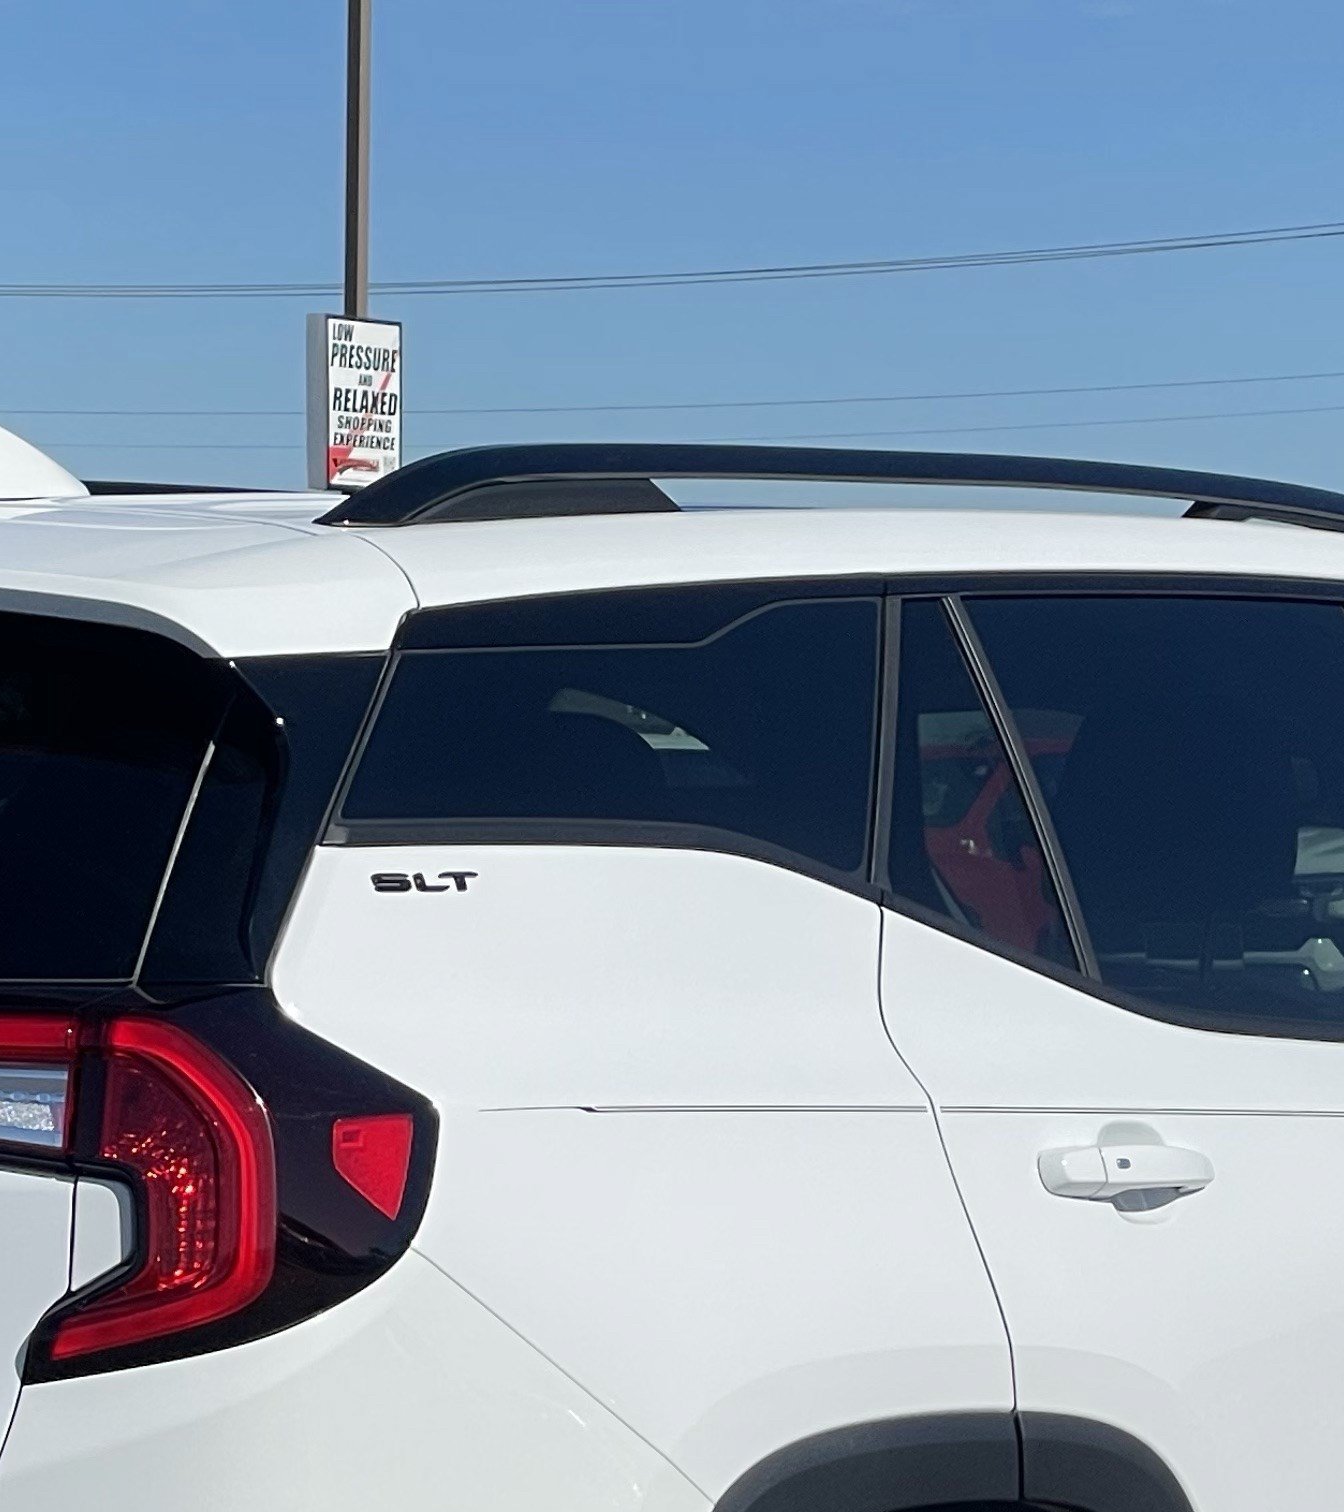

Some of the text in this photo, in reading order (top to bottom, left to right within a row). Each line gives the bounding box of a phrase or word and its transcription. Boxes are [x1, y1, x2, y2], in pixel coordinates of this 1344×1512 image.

[332, 323, 354, 342] LOW
[331, 343, 398, 373] PRESSURE
[358, 373, 372, 387] AND
[333, 387, 398, 416] RELAXED
[337, 415, 392, 433] SHOPPING
[333, 432, 395, 451] EXPERIENCE
[370, 871, 478, 892] SLT
